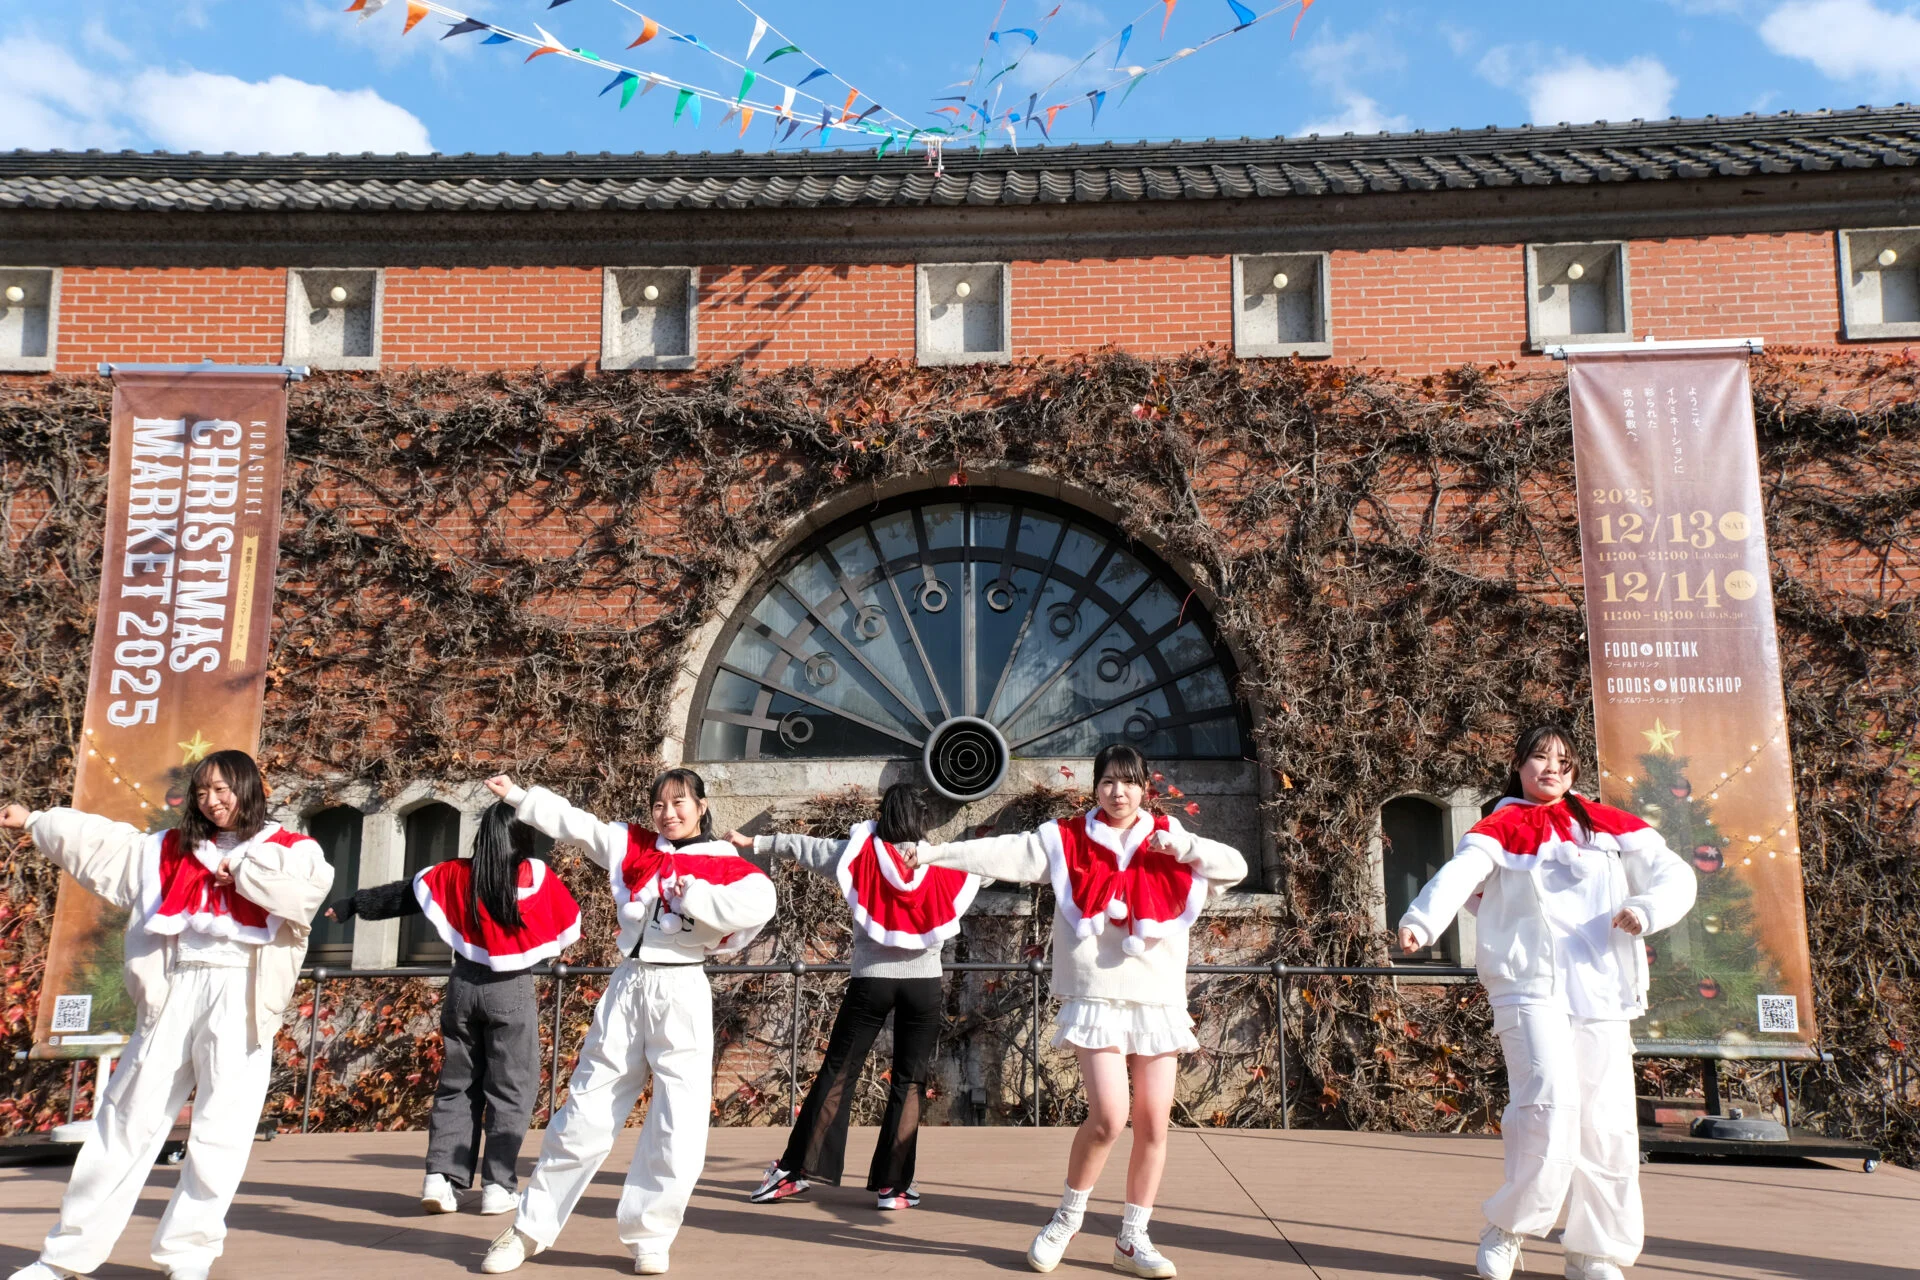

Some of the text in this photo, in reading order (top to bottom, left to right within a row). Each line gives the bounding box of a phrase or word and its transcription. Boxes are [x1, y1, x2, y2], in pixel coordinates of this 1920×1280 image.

[1644, 384, 1658, 429] 彩られた
[1666, 387, 1685, 474] イルミネーションに
[245, 420, 267, 515] KURASHIKI
[1592, 488, 1653, 508] 2025
[169, 418, 243, 673] CHRISTMAS
[1595, 510, 1745, 549] 12/13 SAT
[106, 416, 186, 728] MARKET 2025
[1600, 568, 1752, 608] 12/14 SUN
[1605, 641, 1638, 658] FOOD
[1655, 641, 1699, 658] DRINK
[1607, 677, 1651, 693] GOODS
[1670, 676, 1742, 694] WORKSHOP
